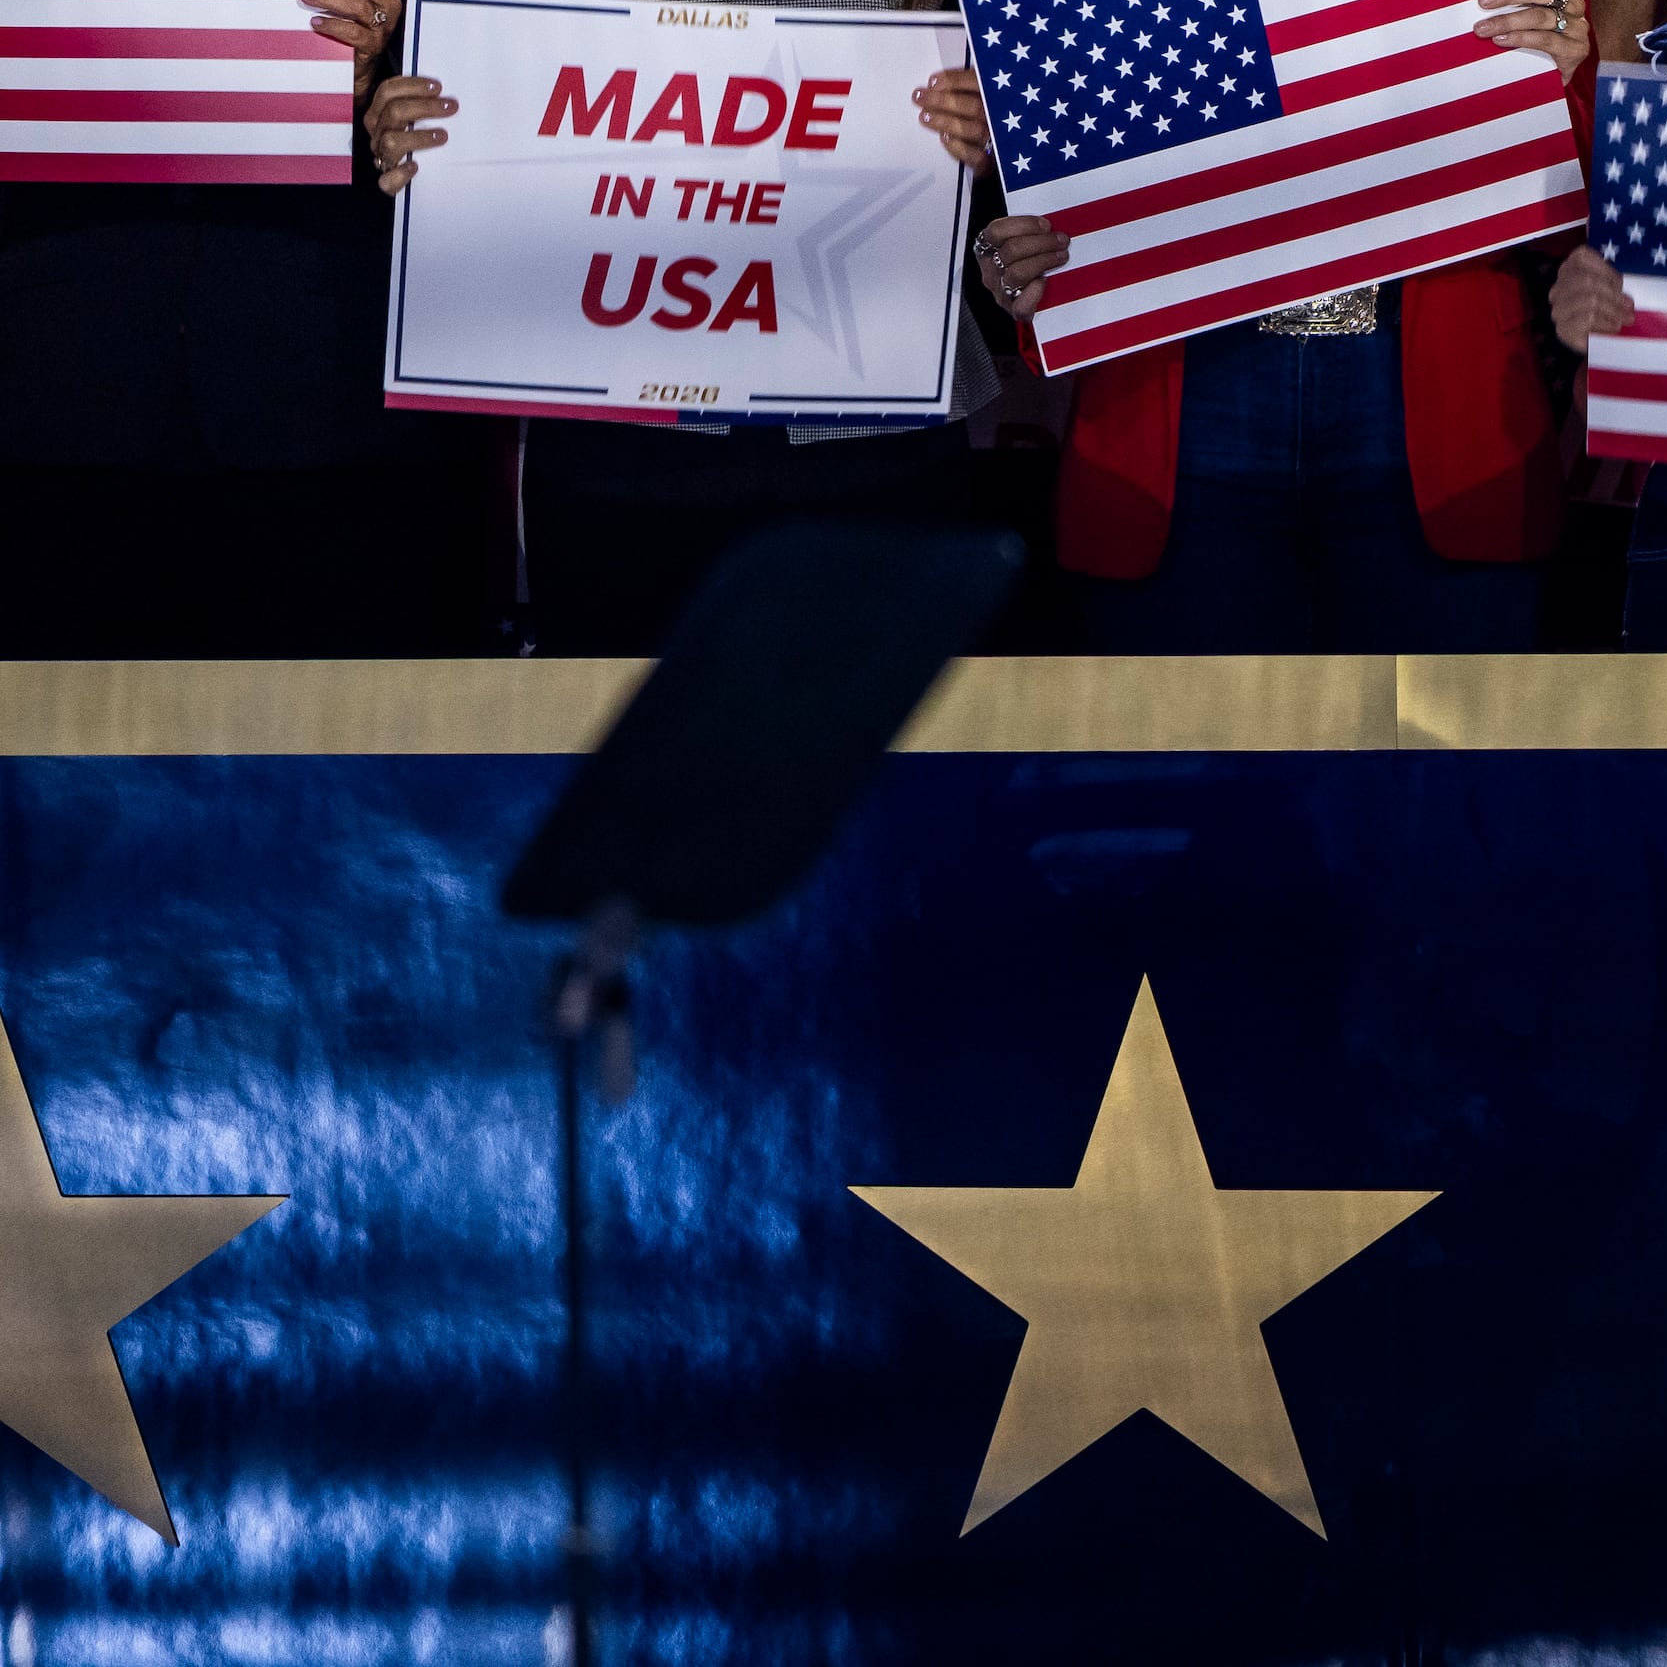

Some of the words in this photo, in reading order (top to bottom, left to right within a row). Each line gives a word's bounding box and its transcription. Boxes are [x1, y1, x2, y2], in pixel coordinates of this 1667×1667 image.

[656, 7, 749, 30] DALLAS
[537, 64, 853, 151] MADE
[590, 173, 656, 219] IN
[673, 179, 786, 225] THE
[581, 252, 778, 335] USA
